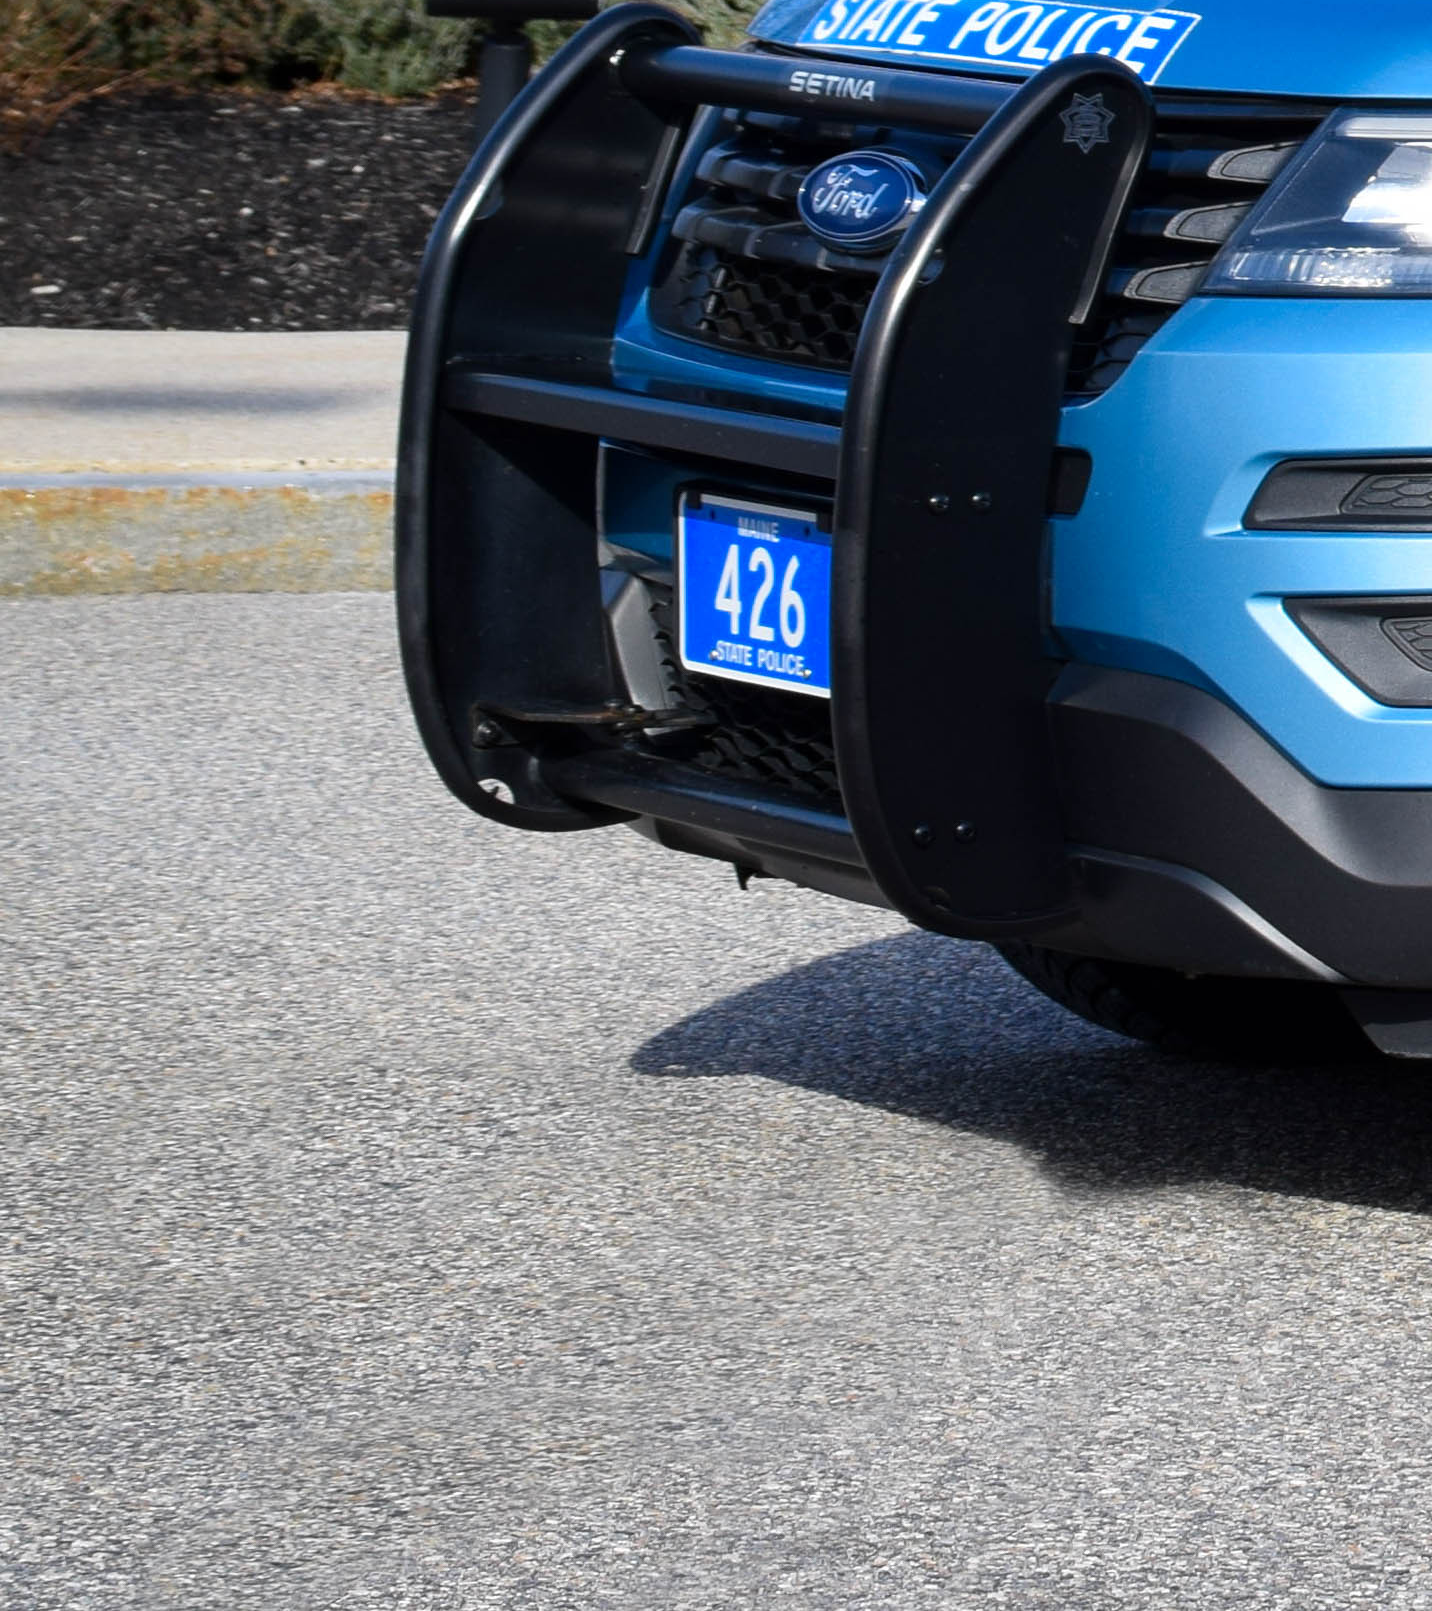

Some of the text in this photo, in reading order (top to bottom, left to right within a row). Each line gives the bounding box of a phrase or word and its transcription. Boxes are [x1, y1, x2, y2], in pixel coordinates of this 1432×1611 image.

[949, 1, 1177, 70] POLICE
[789, 71, 875, 102] SETINA
[812, 164, 888, 219] Ford
[738, 517, 779, 542] MAINE
[715, 544, 806, 648] 426
[716, 640, 805, 676] STATE POLICE
